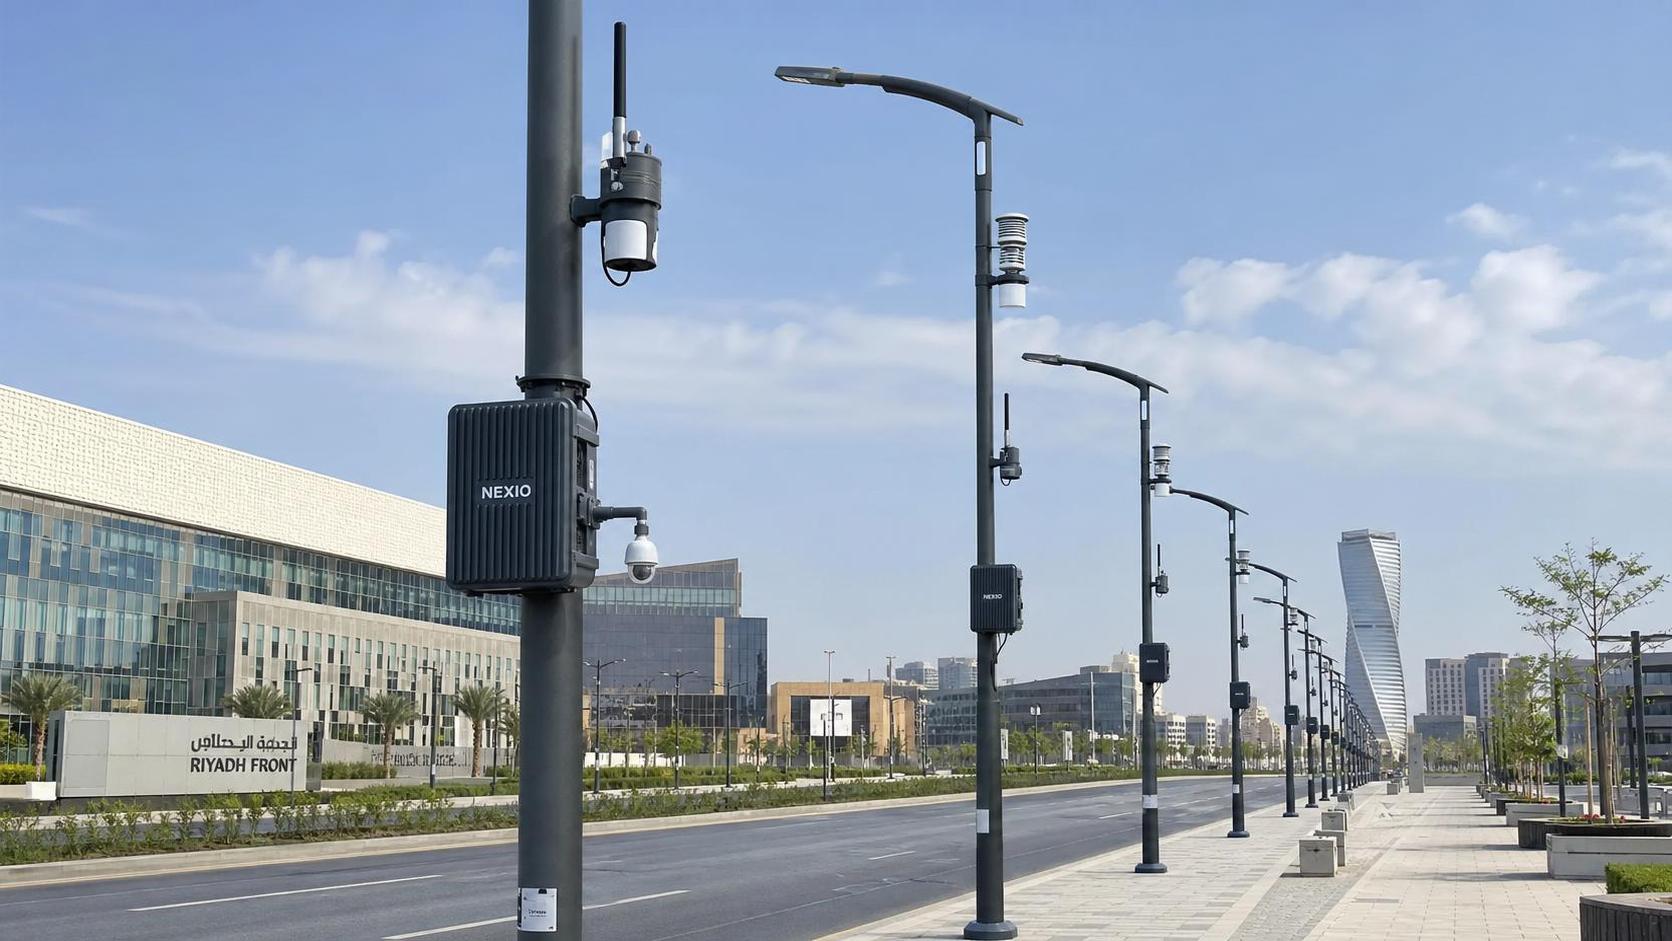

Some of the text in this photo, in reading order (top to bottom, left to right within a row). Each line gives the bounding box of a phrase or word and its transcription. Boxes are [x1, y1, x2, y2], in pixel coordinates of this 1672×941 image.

[481, 484, 531, 499] NEXIO
[190, 757, 297, 773] RIYADH FRONT
